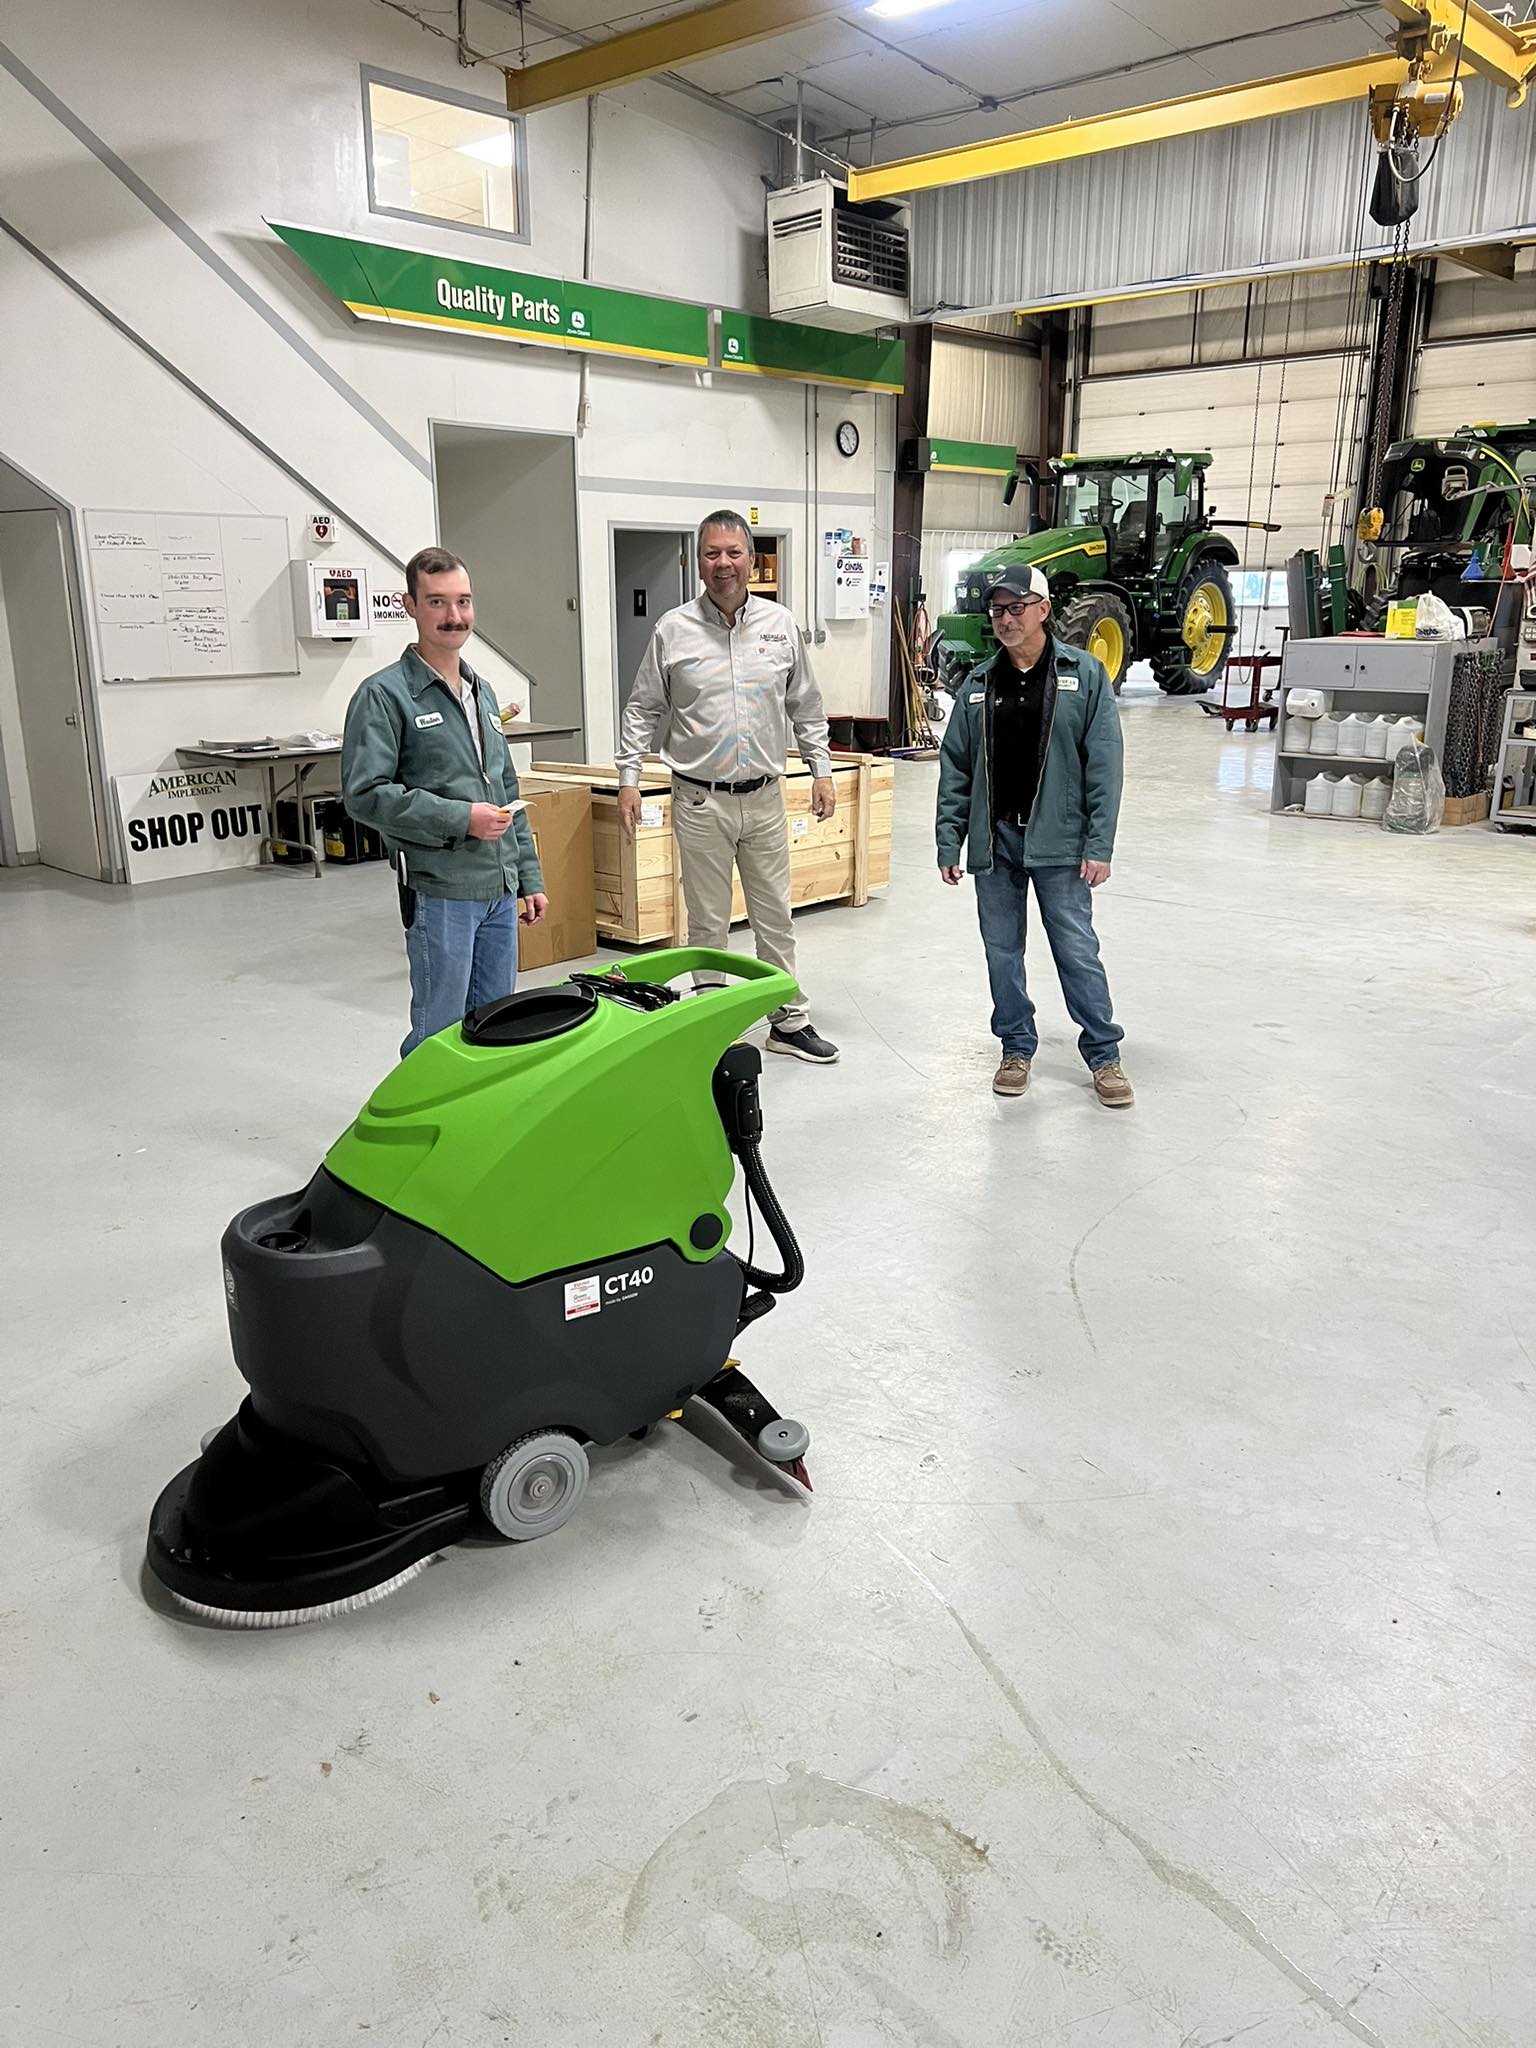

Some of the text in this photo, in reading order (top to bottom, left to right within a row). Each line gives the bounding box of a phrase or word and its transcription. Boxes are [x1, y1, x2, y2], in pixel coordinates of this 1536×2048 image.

[437, 278, 560, 324] Quality Parts
[312, 516, 330, 524] AED
[336, 570, 352, 578] AED
[373, 595, 390, 607] NO
[148, 770, 237, 797] AMERICAN
[168, 786, 222, 799] IMPLEMENT
[128, 804, 262, 852] SHOP OUT
[604, 1266, 654, 1295] CT40
